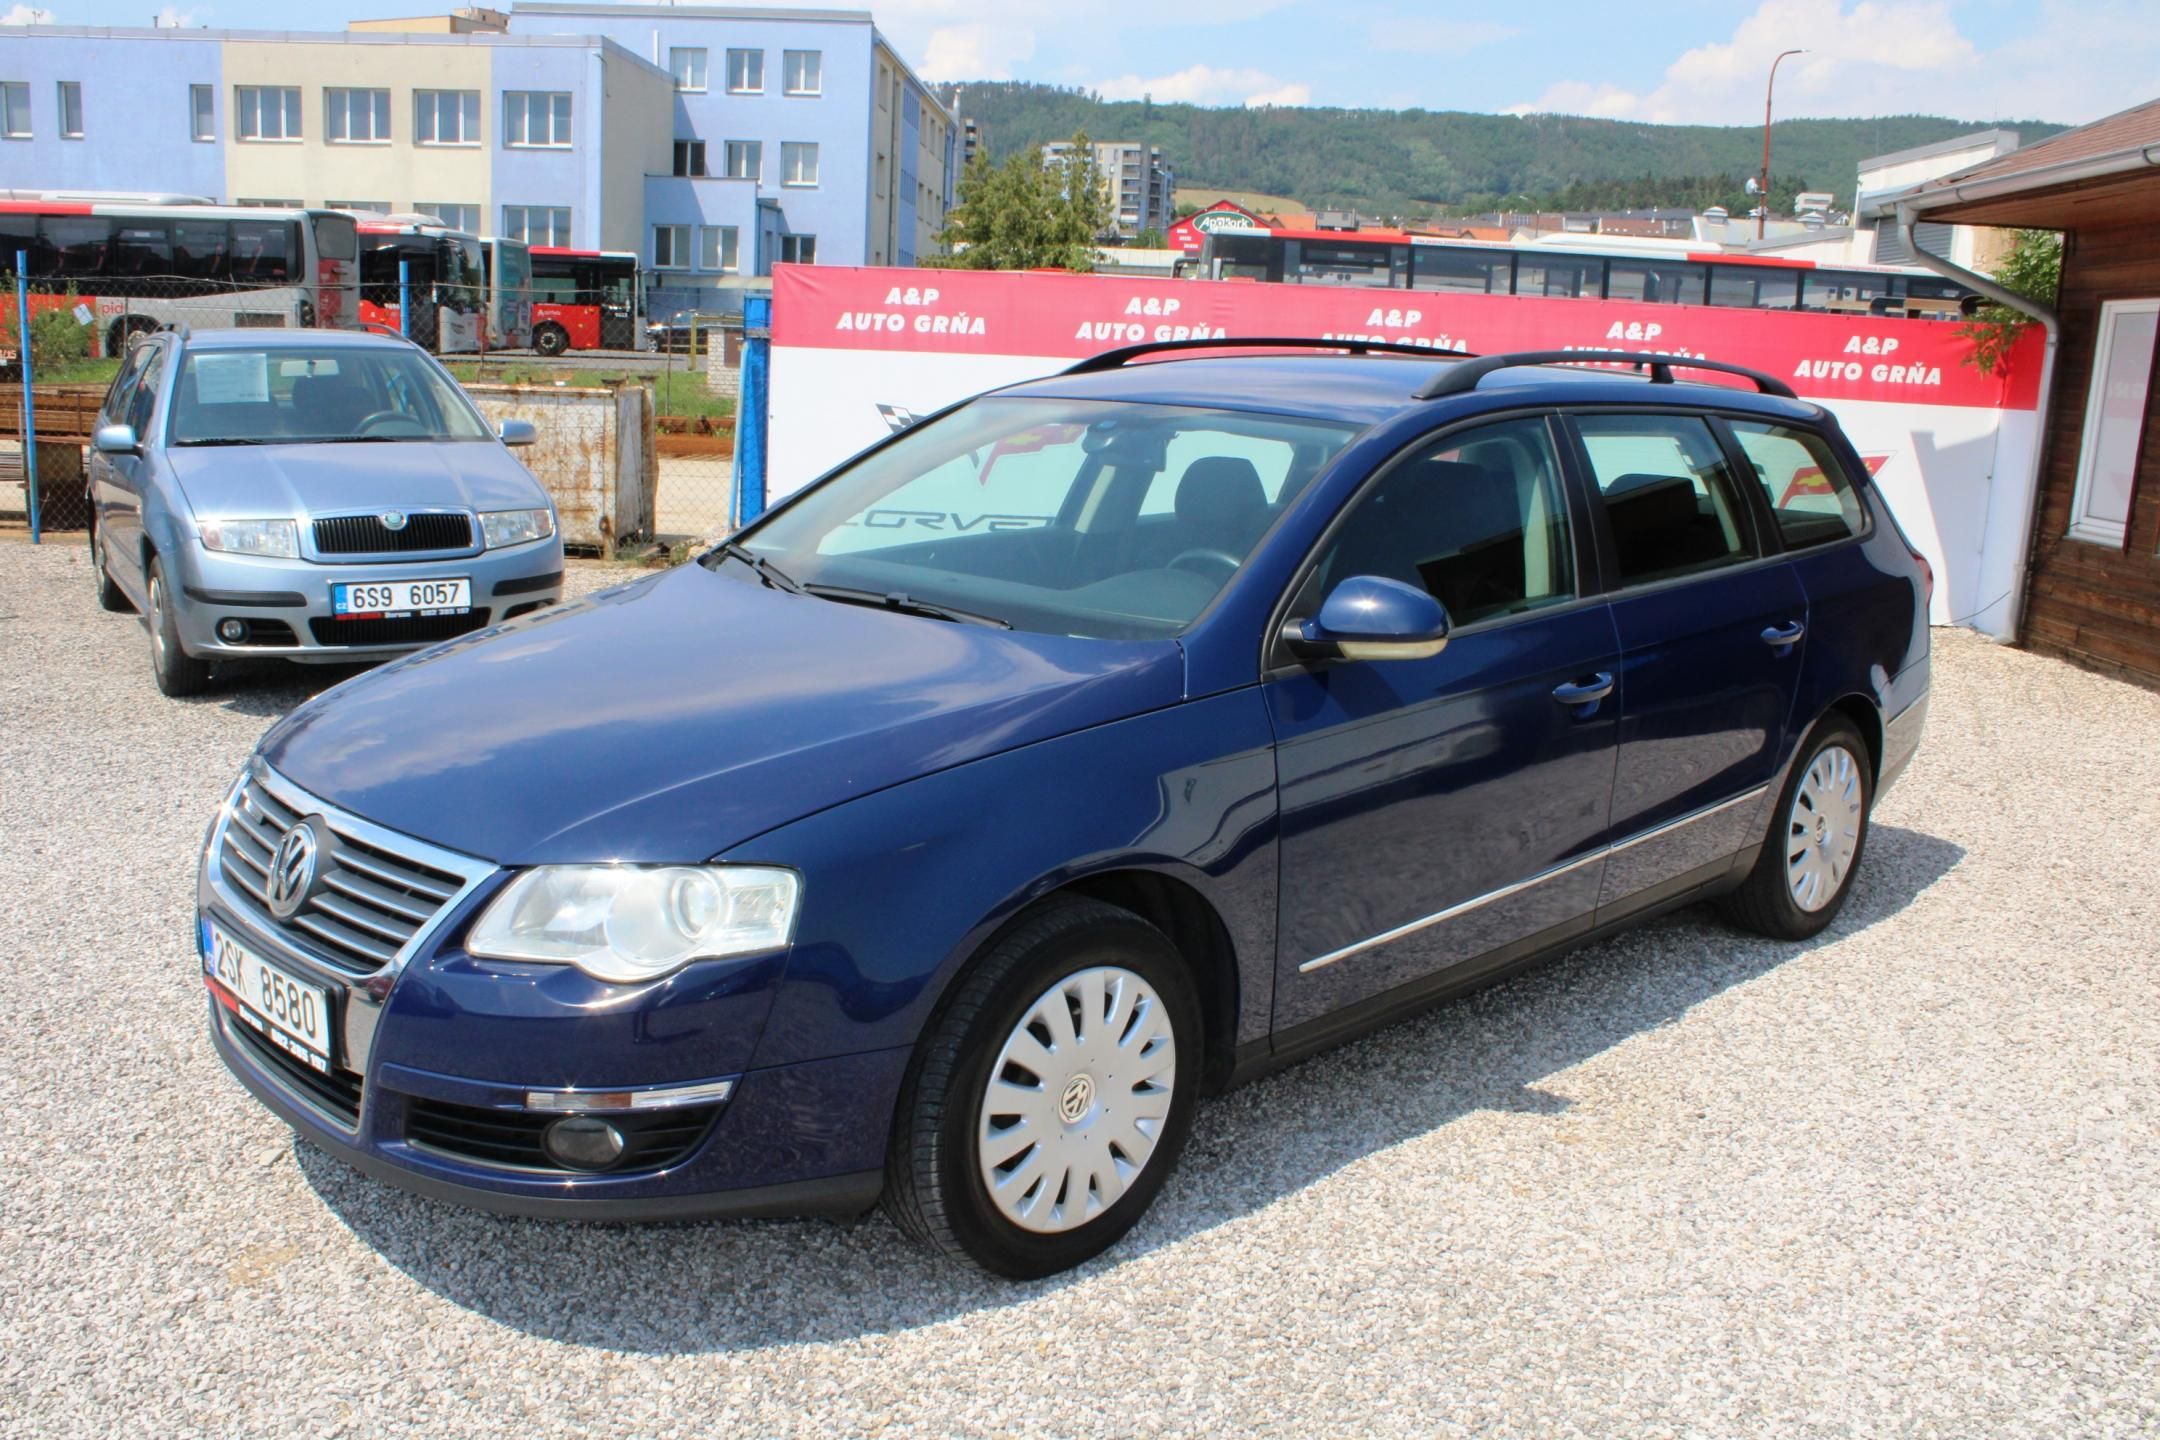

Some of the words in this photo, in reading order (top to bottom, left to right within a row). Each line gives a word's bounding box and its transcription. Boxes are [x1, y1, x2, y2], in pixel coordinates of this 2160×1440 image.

[884, 287, 940, 306] A&P
[1124, 296, 1180, 315] A&P
[102, 302, 124, 314] pid
[1366, 308, 1422, 327] A&P
[835, 312, 905, 332] AUTO
[914, 311, 985, 335] GRŇA
[1074, 321, 1145, 341] AUTO
[1154, 322, 1226, 342] GRŇA
[1606, 320, 1662, 341] A&P
[1843, 335, 1899, 355] A&P
[1793, 360, 1863, 380] AUTO
[1871, 361, 1941, 385] GRŇA
[353, 587, 392, 608] 6S9
[410, 583, 460, 605] 6057
[215, 932, 247, 995] 2SK
[261, 966, 317, 1039] 8580
